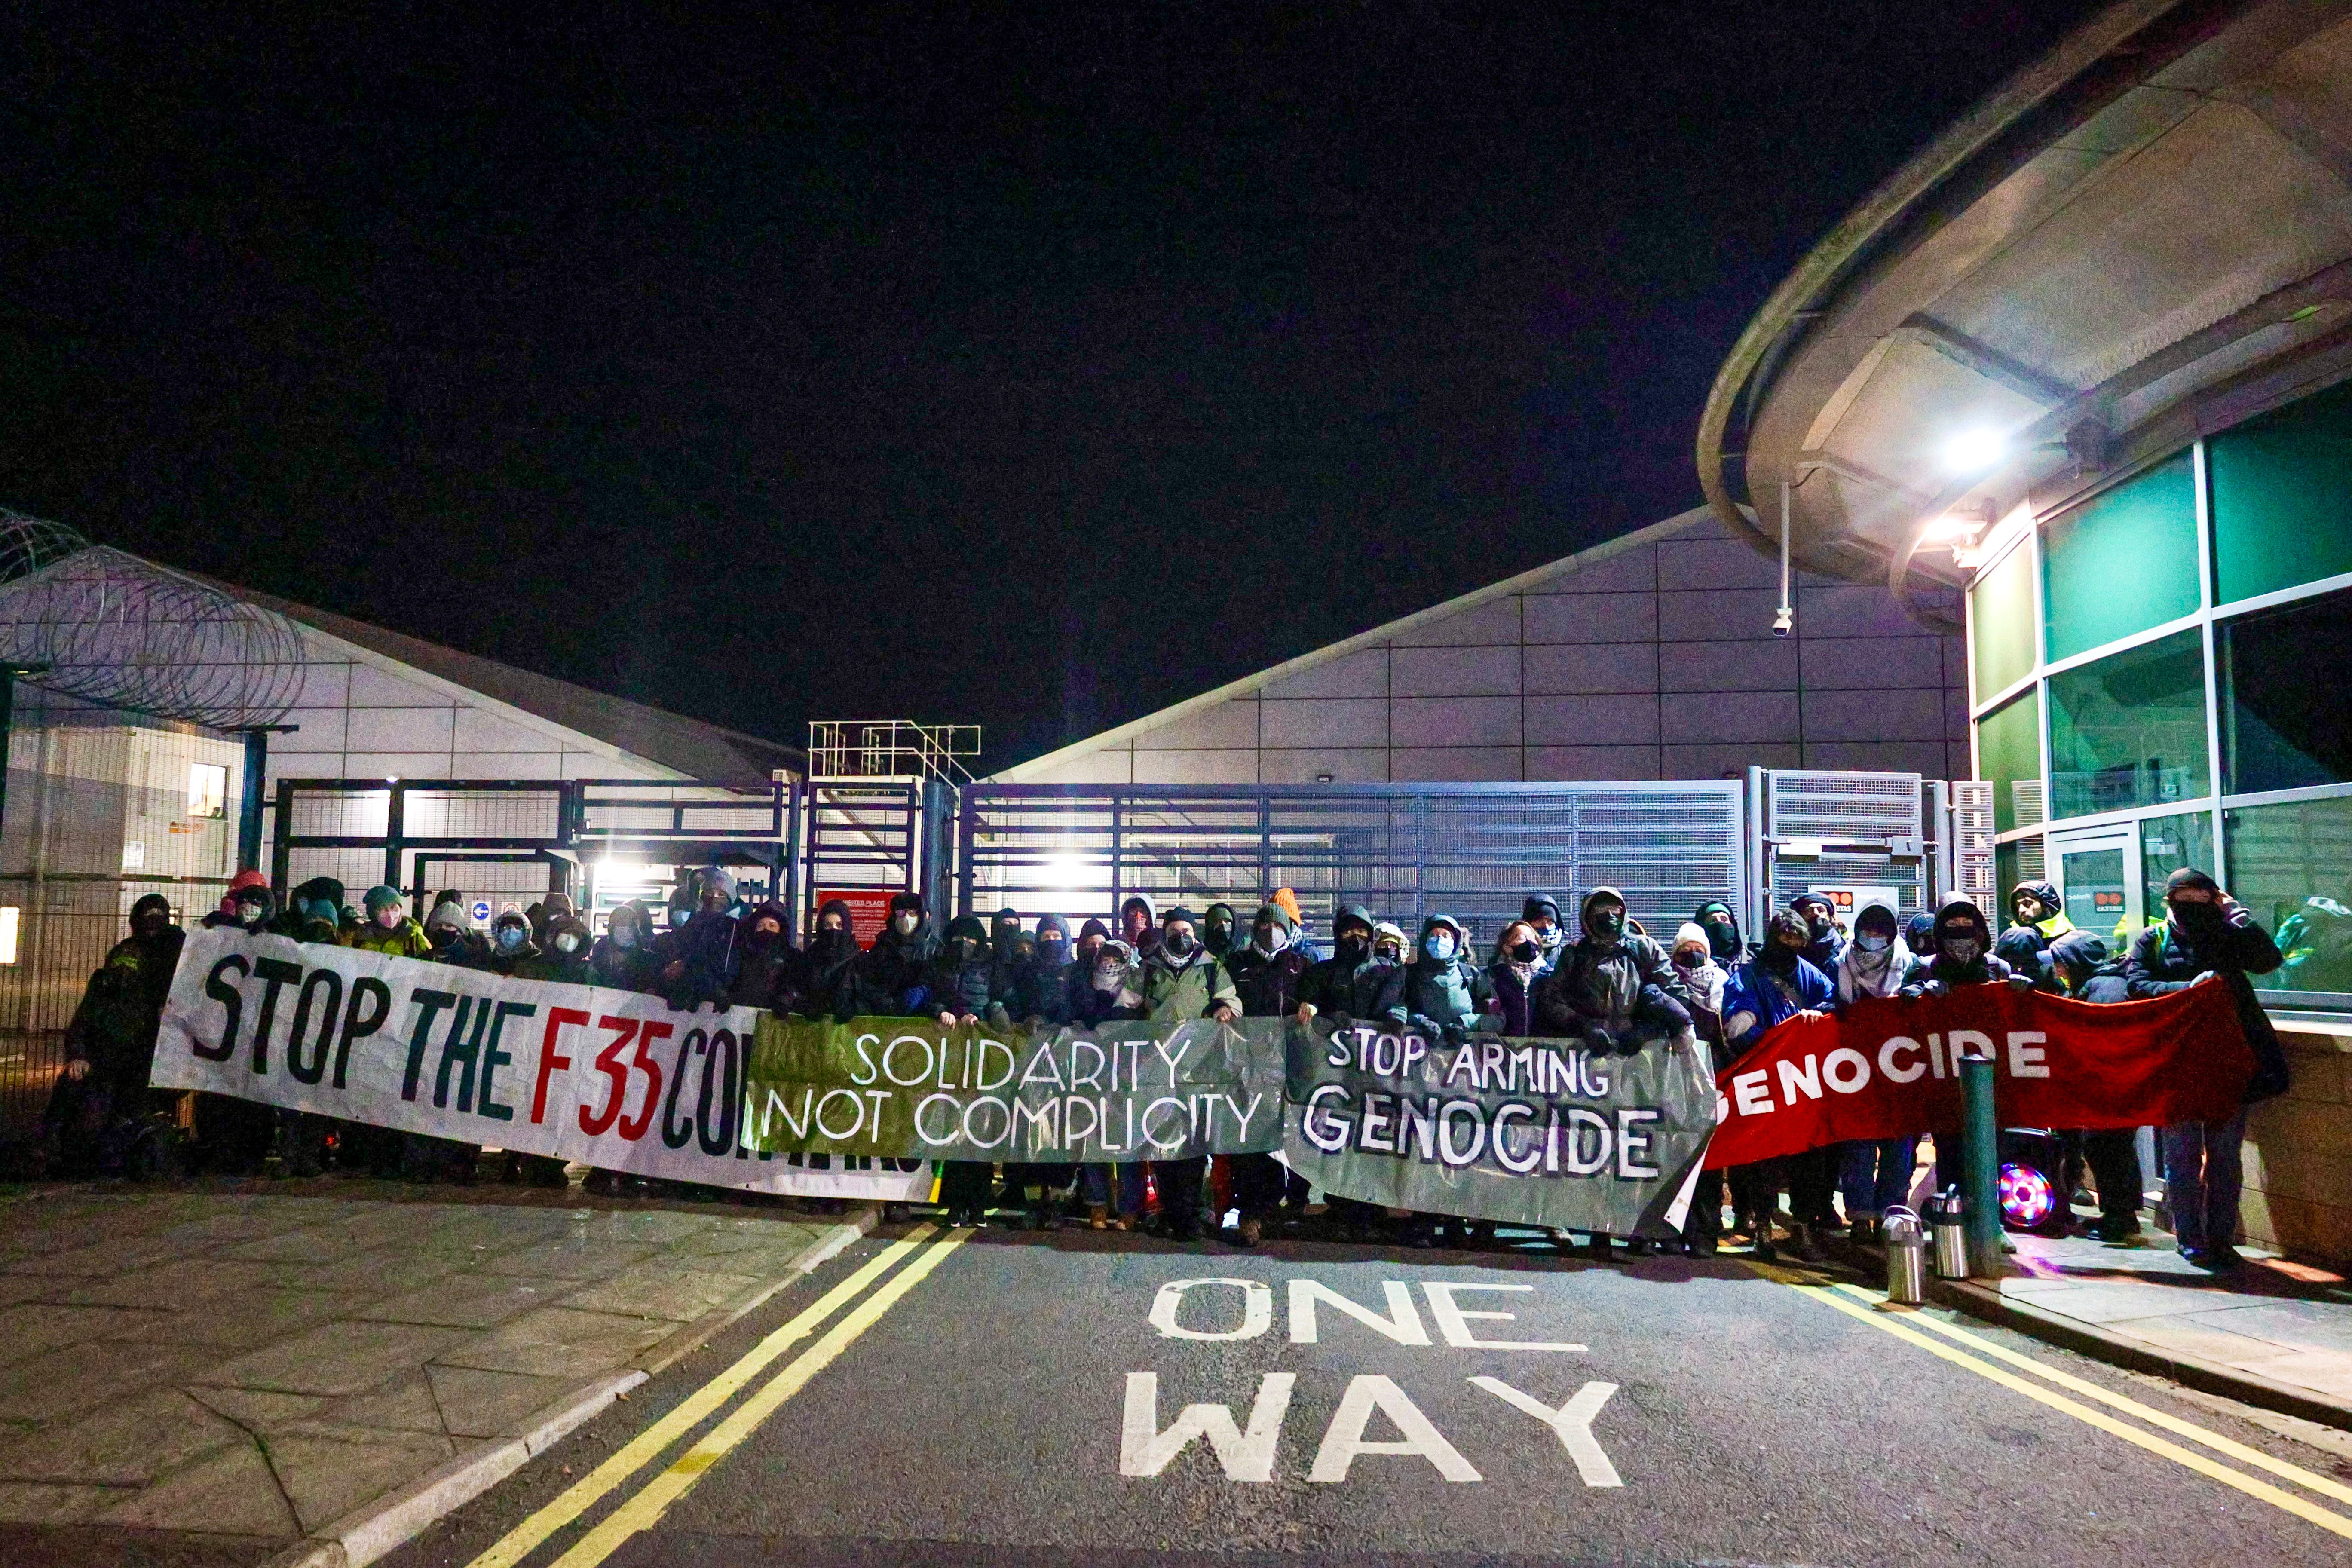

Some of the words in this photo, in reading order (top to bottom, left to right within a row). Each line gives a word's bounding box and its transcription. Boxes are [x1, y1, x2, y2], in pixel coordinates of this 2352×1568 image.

[193, 954, 391, 1090] STOP
[401, 988, 536, 1121] THE
[851, 1033, 1191, 1092] SOLIDARITY
[1328, 1028, 1426, 1077] STOP
[1447, 1043, 1609, 1098] ARMING
[762, 1088, 892, 1143] NOT
[914, 1093, 1262, 1151] COMPLICITY
[1303, 1085, 1659, 1179] GENOCIDE
[1148, 1277, 1589, 1351] ONE
[1118, 1372, 1624, 1487] WAY
